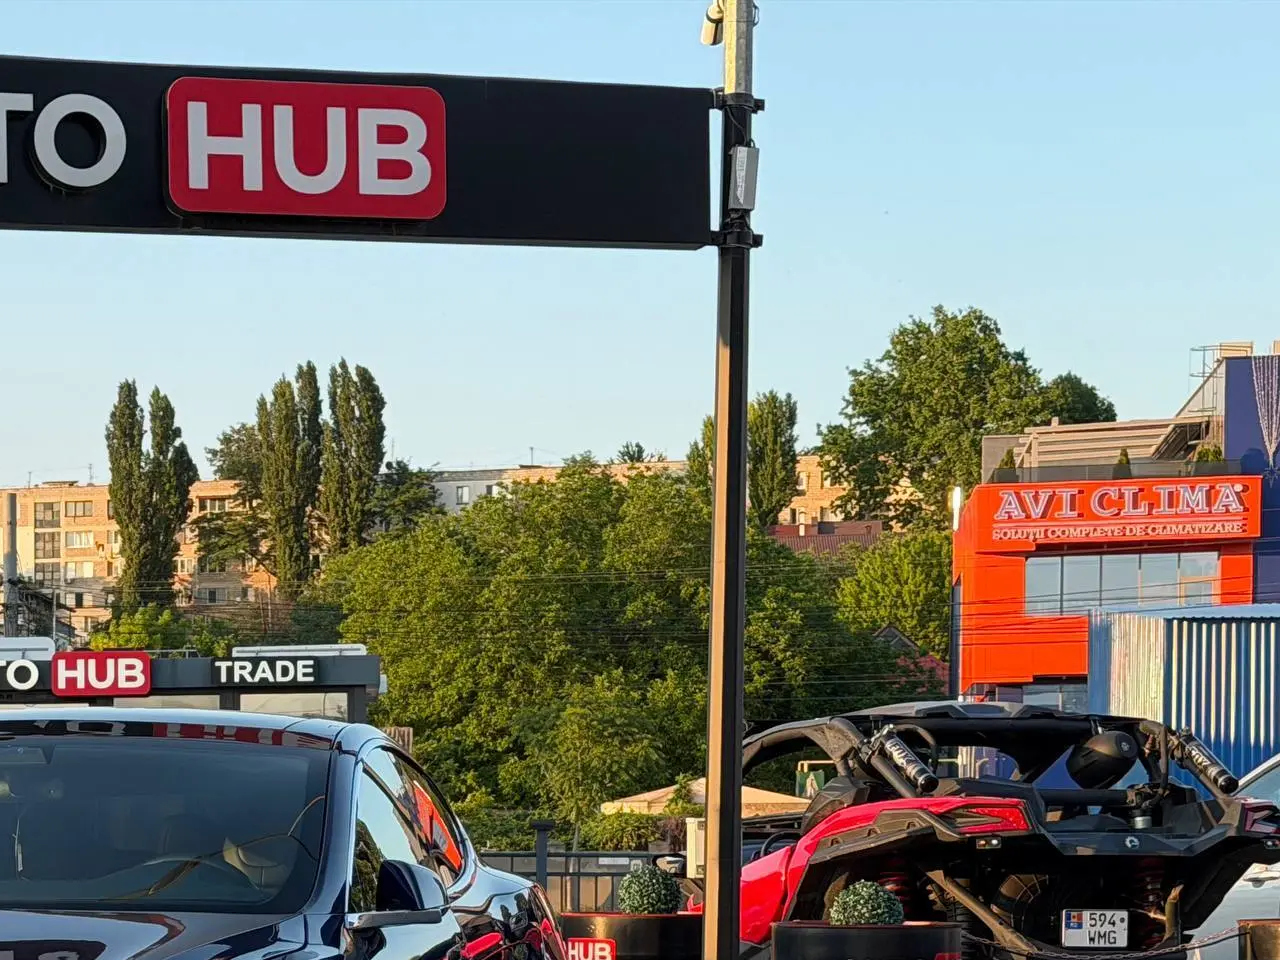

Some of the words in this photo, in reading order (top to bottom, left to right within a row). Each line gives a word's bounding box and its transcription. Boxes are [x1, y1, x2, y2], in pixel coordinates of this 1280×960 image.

[187, 100, 432, 196] HUB
[994, 489, 1079, 521] AVI
[1091, 484, 1244, 517] CLIMA
[1048, 526, 1122, 539] COMPLETE
[1125, 525, 1144, 537] DE
[1148, 522, 1244, 536] CLIMATIZARE
[57, 658, 145, 690] HUB
[215, 659, 314, 684] TRADE
[1088, 912, 1117, 928] 594
[1088, 930, 1117, 945] WMG
